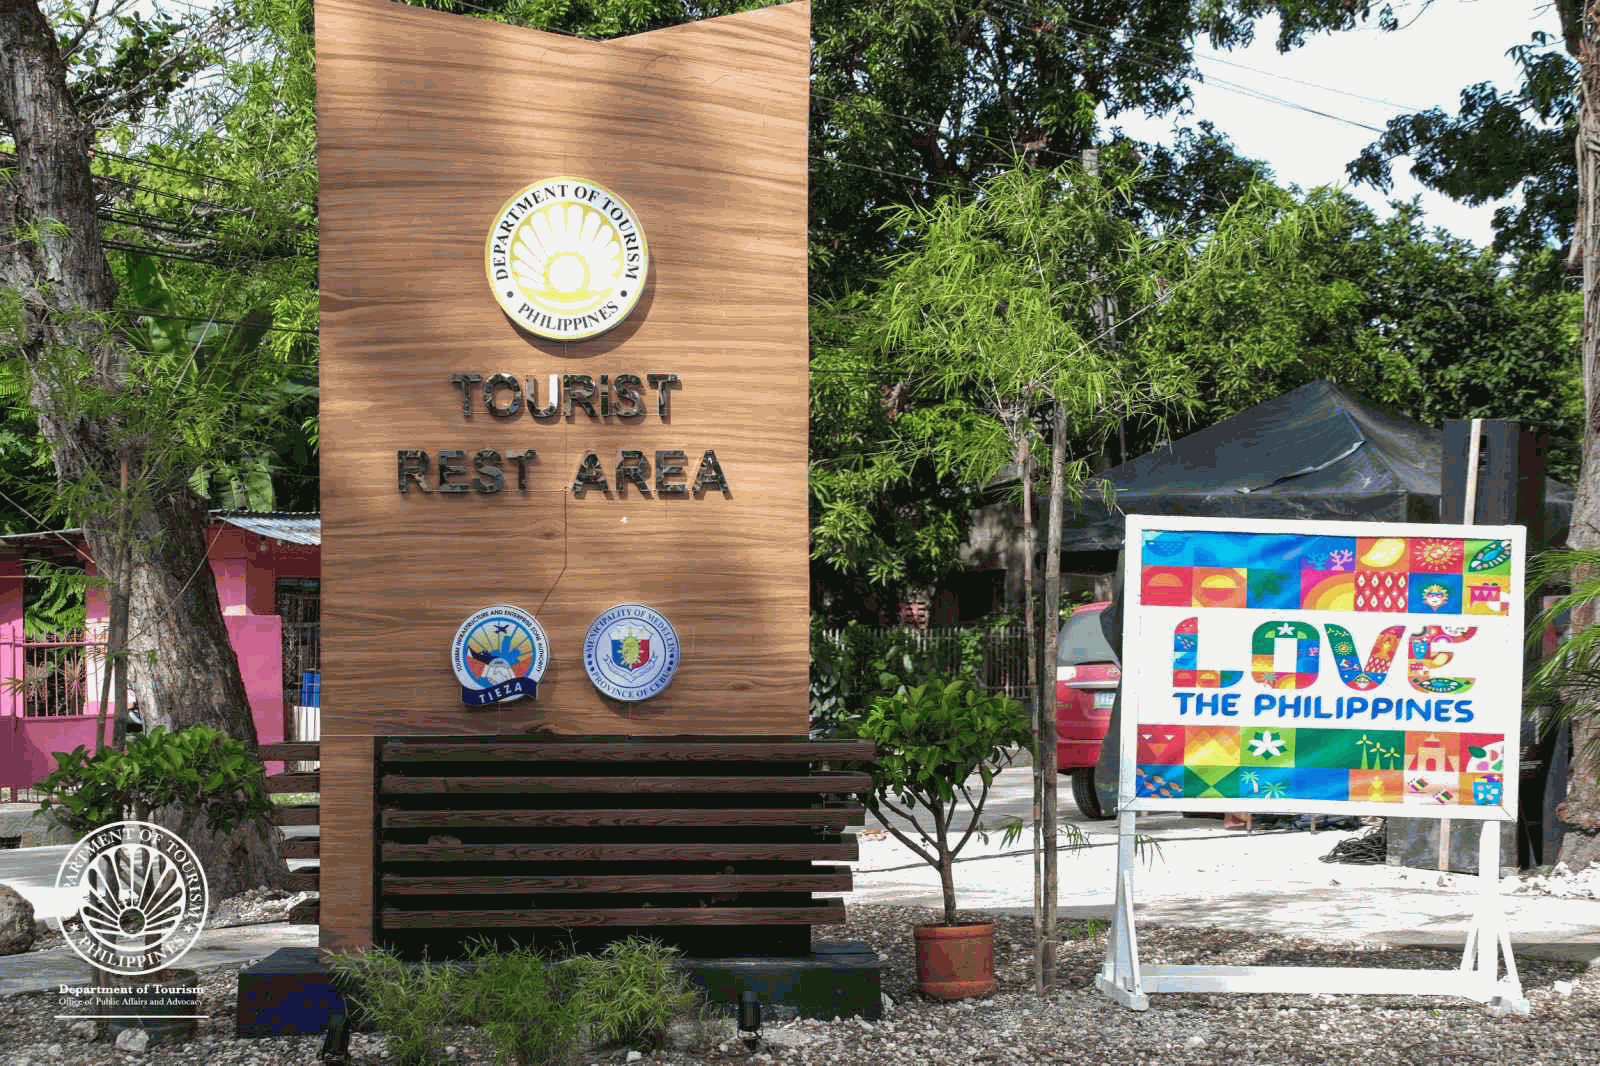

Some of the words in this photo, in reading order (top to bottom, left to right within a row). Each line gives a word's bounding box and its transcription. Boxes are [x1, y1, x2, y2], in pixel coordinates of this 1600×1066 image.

[493, 184, 568, 281] DEPARTMENT
[574, 185, 600, 203] OF
[602, 196, 640, 280] TOURISM
[517, 300, 619, 331] PHILIPPINES
[450, 373, 681, 418] TOURIST
[397, 449, 537, 494] REST
[571, 449, 732, 495] AREA
[585, 608, 632, 652] MUNICIPALITY
[634, 609, 646, 618] OF
[1172, 616, 1478, 694] LOVE
[478, 681, 523, 704] TIEZA
[591, 670, 634, 698] PROVINCE
[636, 688, 648, 698] OF
[648, 671, 670, 693] CEBU
[1172, 691, 1242, 717] THE
[1253, 693, 1475, 723] PHILIPPINES
